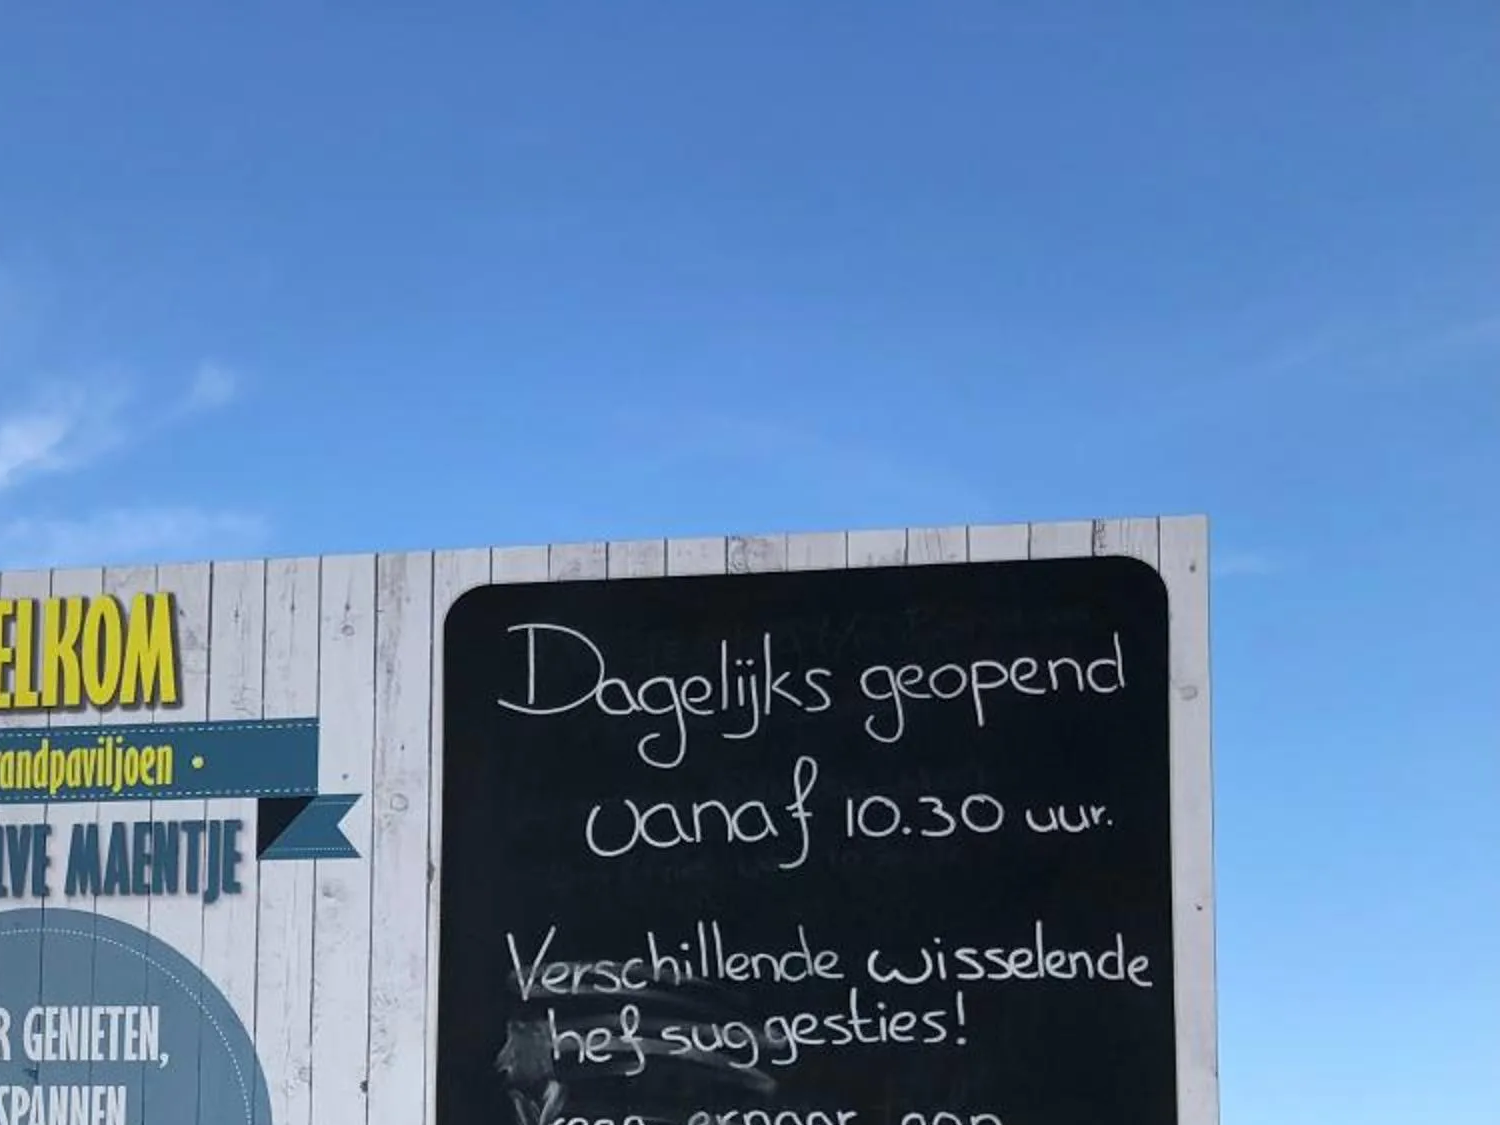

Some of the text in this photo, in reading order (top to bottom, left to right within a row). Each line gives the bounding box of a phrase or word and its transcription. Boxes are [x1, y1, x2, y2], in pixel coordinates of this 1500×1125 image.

[497, 622, 1126, 769] Dagelijks geopend
[585, 756, 1113, 869] vanaf 10.30 uur.
[64, 819, 244, 904] MAENTJE
[505, 920, 1153, 1001] Verschillende wisselende
[22, 1005, 170, 1069] GENIETEN,
